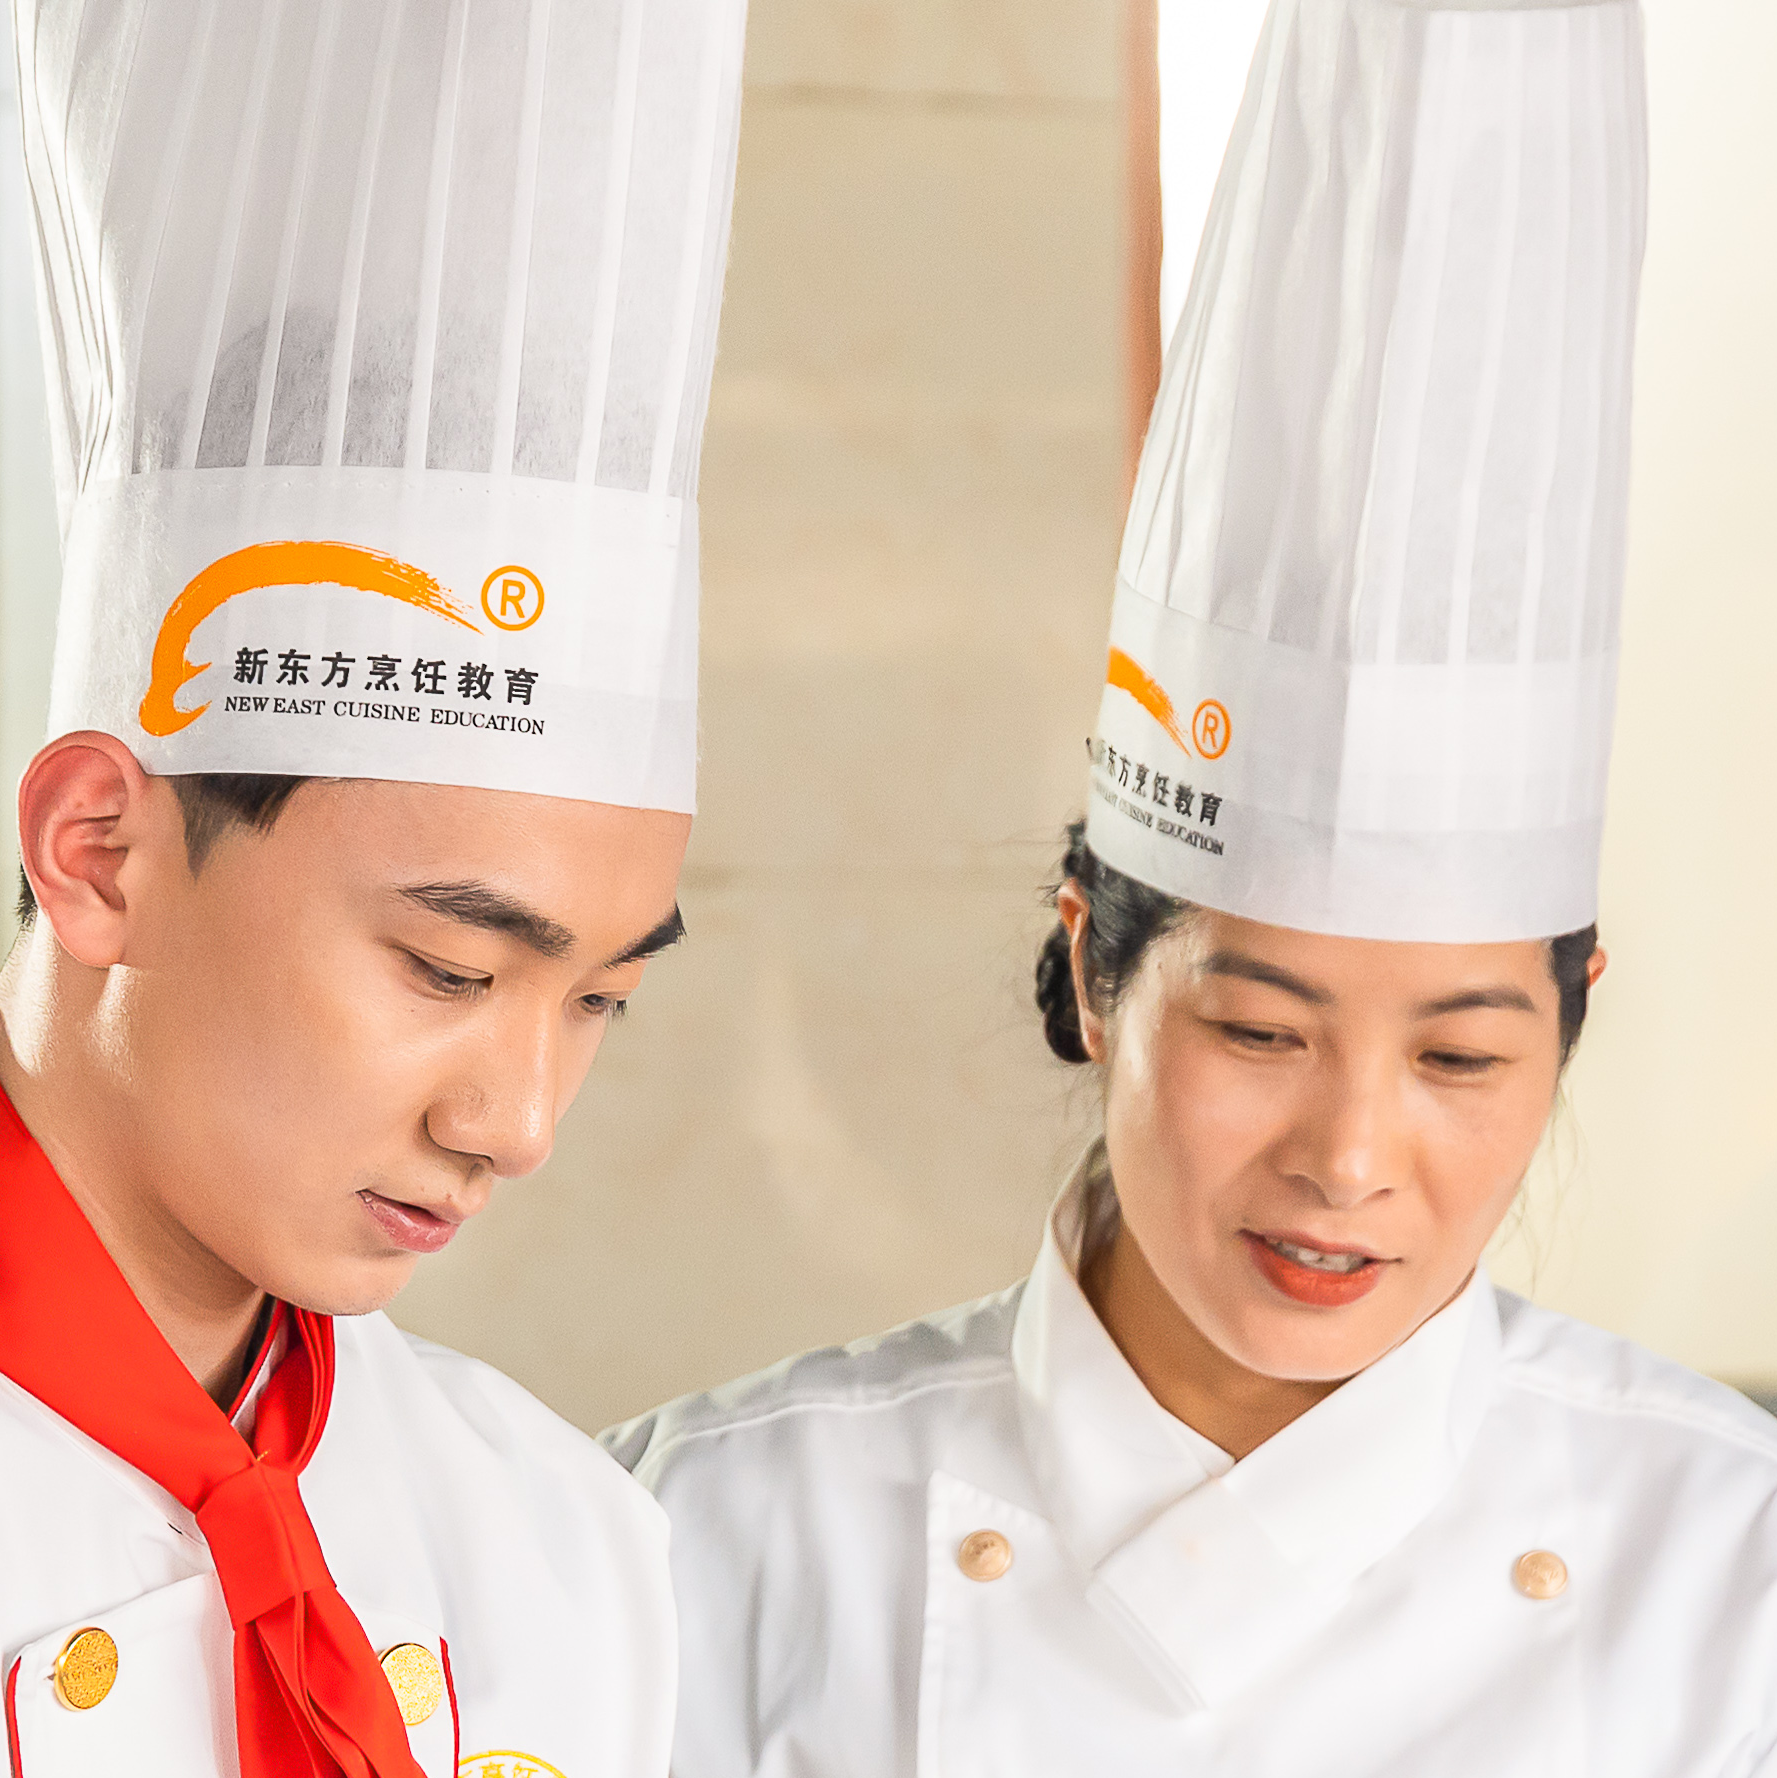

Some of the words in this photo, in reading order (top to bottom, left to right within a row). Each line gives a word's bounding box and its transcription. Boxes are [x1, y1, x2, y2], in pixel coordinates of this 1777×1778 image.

[233, 647, 539, 706] 新东方烹饪教育
[224, 696, 270, 712] NEW
[273, 698, 326, 715] EAST
[333, 700, 420, 722] CUISINE
[430, 708, 545, 735] EDUCATION
[1089, 740, 1223, 827] 东方烹饪教育
